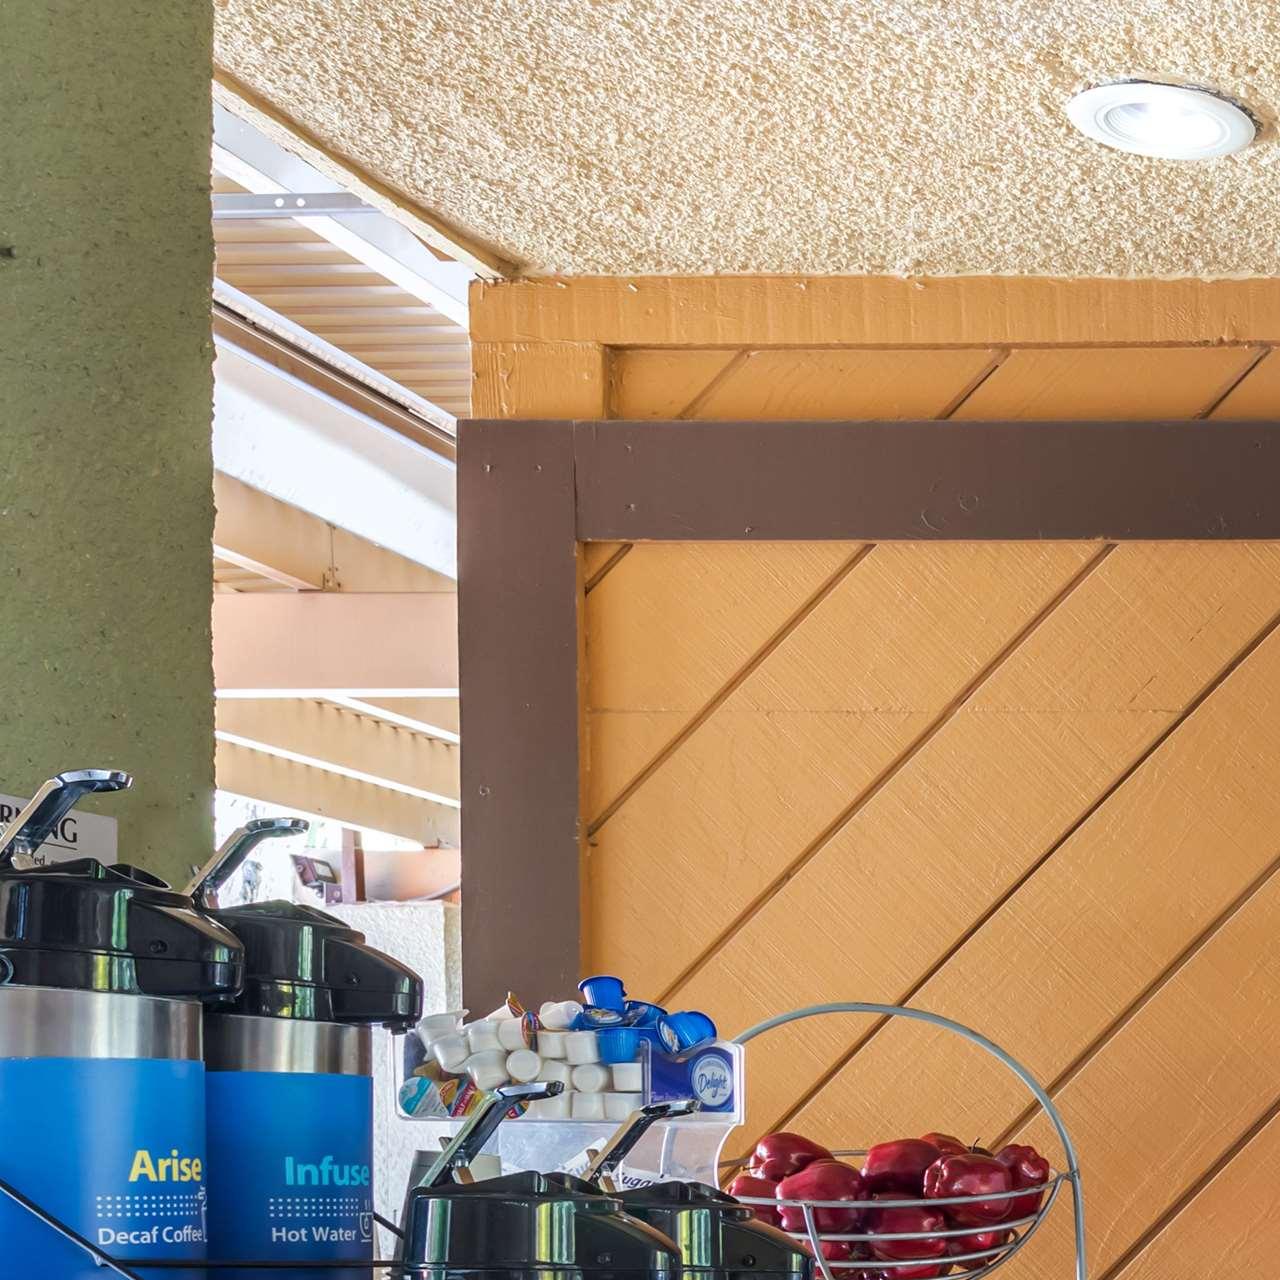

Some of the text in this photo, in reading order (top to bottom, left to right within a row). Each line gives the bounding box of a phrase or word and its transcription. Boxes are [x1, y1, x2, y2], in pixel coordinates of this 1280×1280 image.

[698, 1071, 728, 1098] Delight
[128, 1149, 202, 1183] Arise
[285, 1155, 369, 1187] Infuse
[99, 1225, 203, 1245] Decaf Coffee
[271, 1226, 356, 1243] Hot Water
